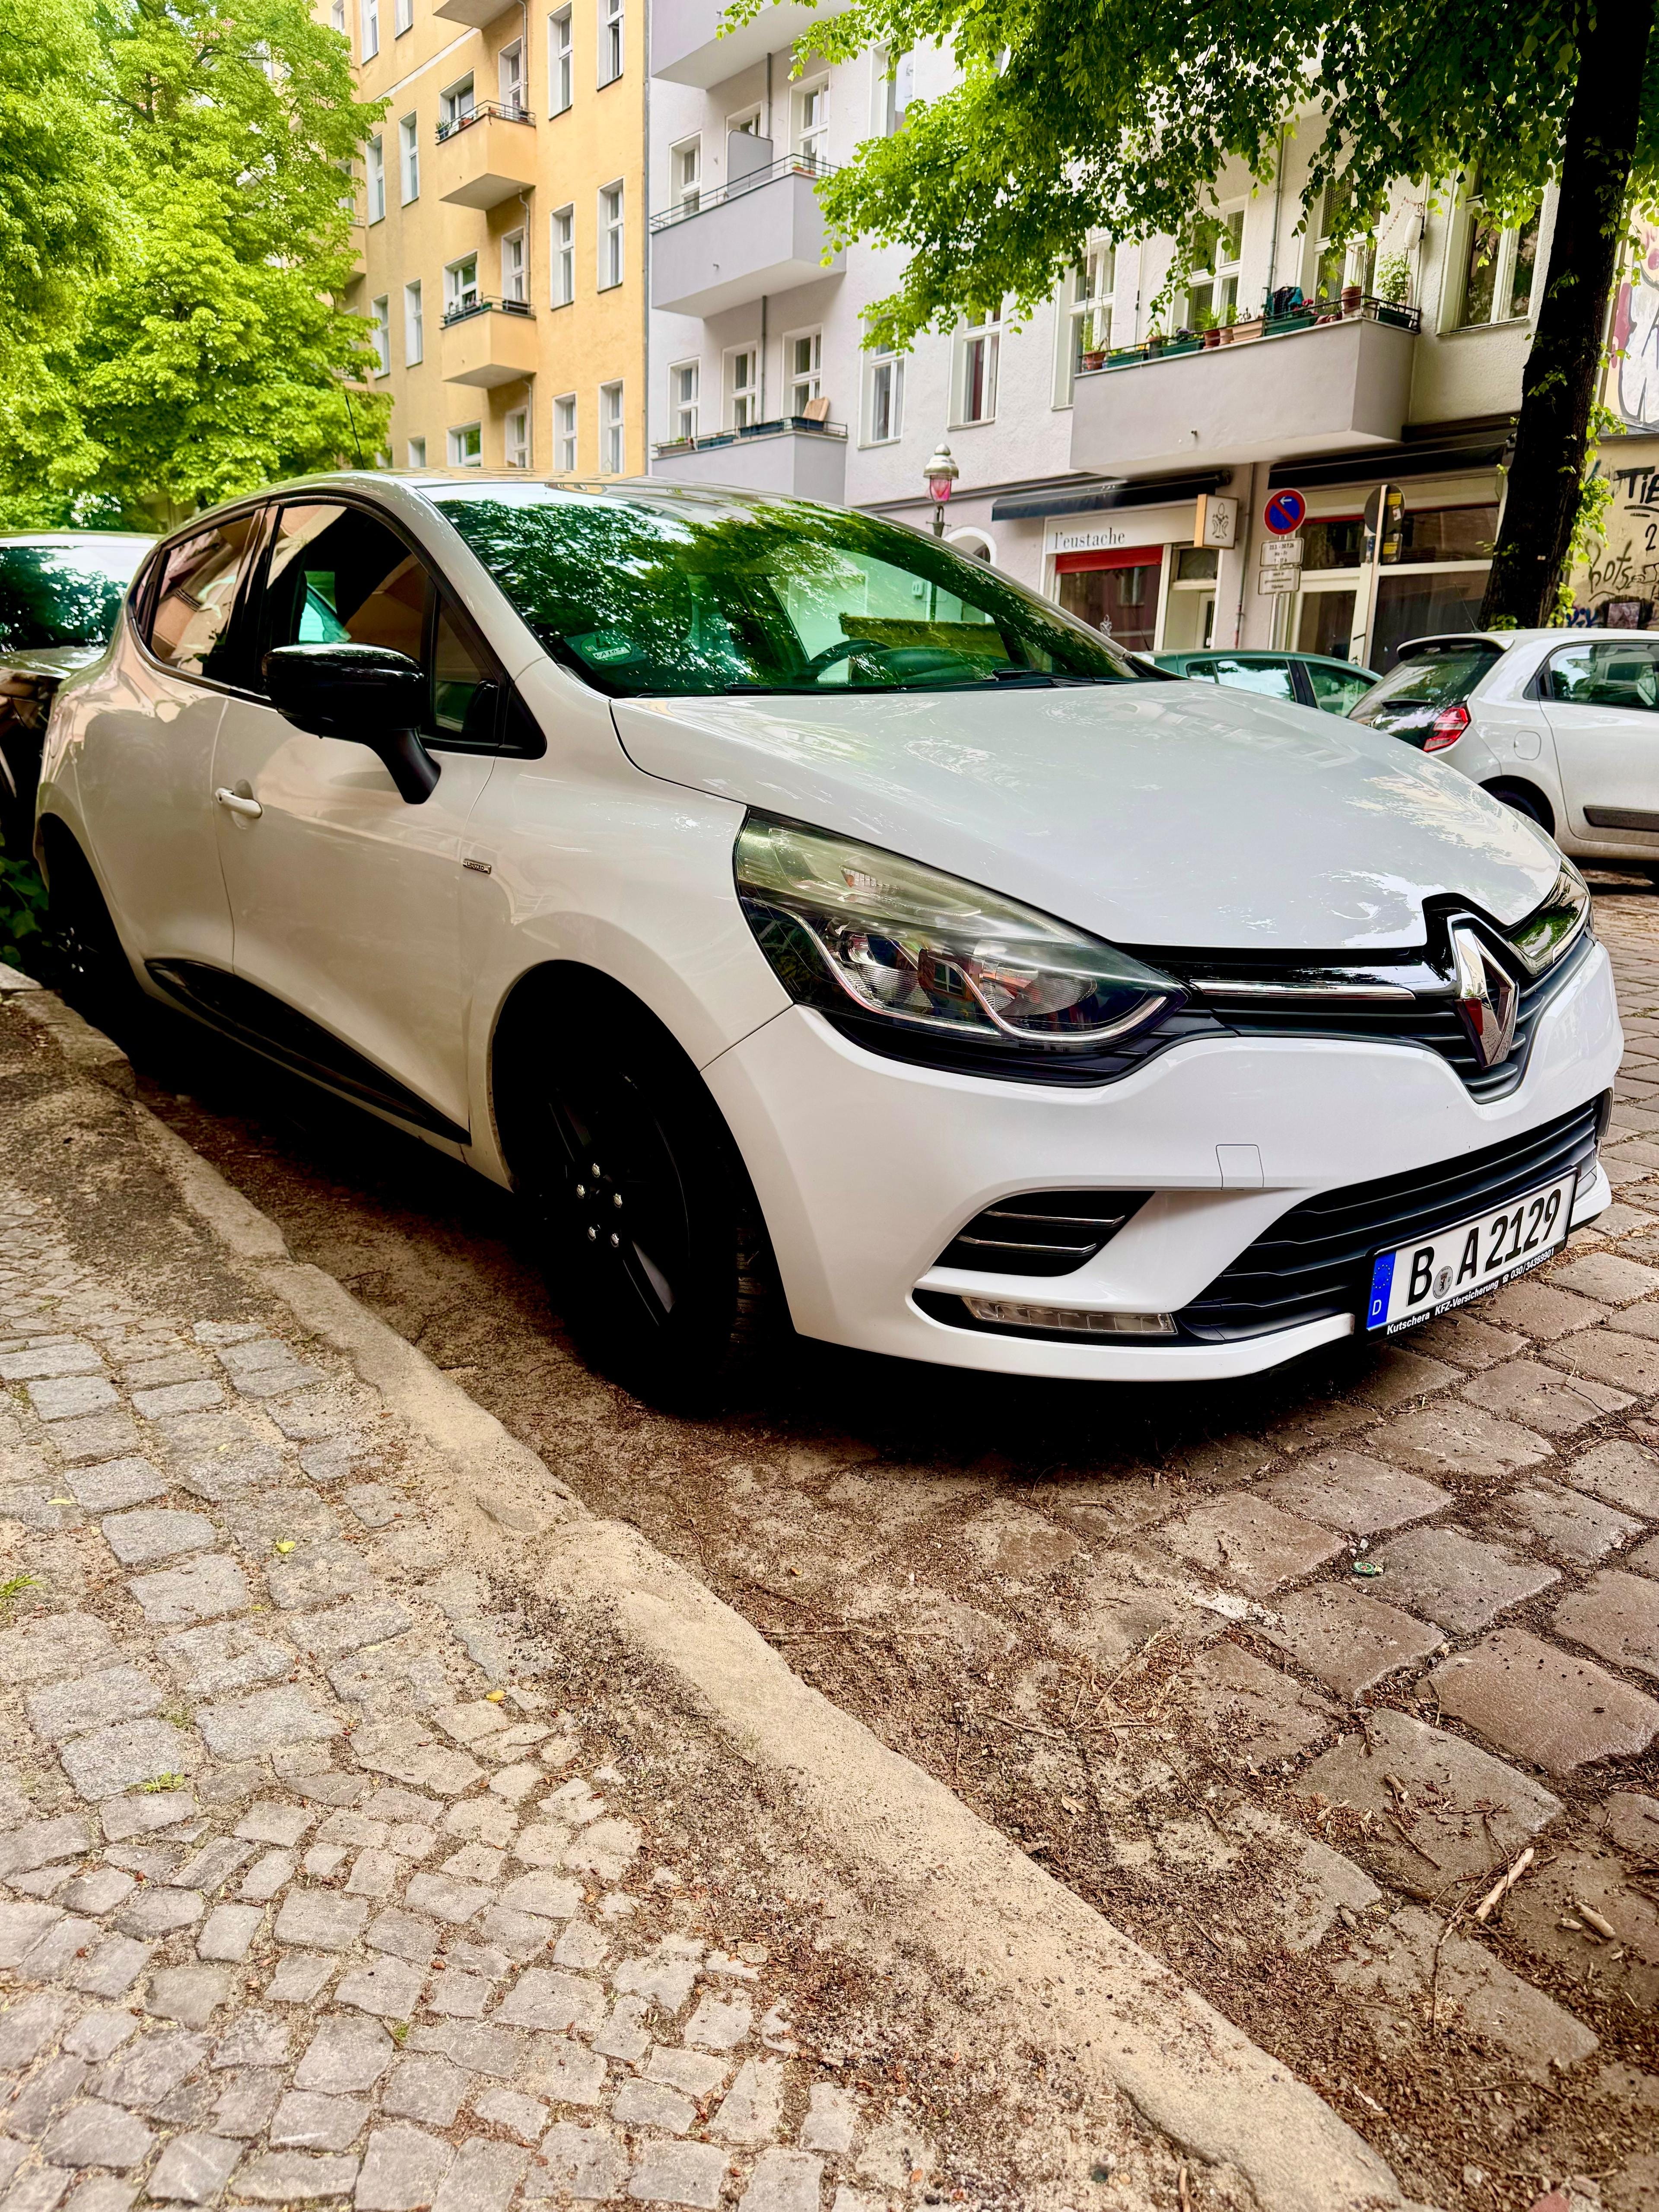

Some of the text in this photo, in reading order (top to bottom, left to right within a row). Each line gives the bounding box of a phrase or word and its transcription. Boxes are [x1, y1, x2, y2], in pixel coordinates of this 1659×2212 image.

[1055, 527, 1125, 550] l'eustache
[1407, 1189, 1561, 1306] B A 2129
[1372, 1299, 1382, 1316] D
[1387, 1312, 1430, 1335] Kutschera
[1435, 1279, 1499, 1316] KFZ-Versicherung
[1510, 1247, 1554, 1279] 030/34359901
